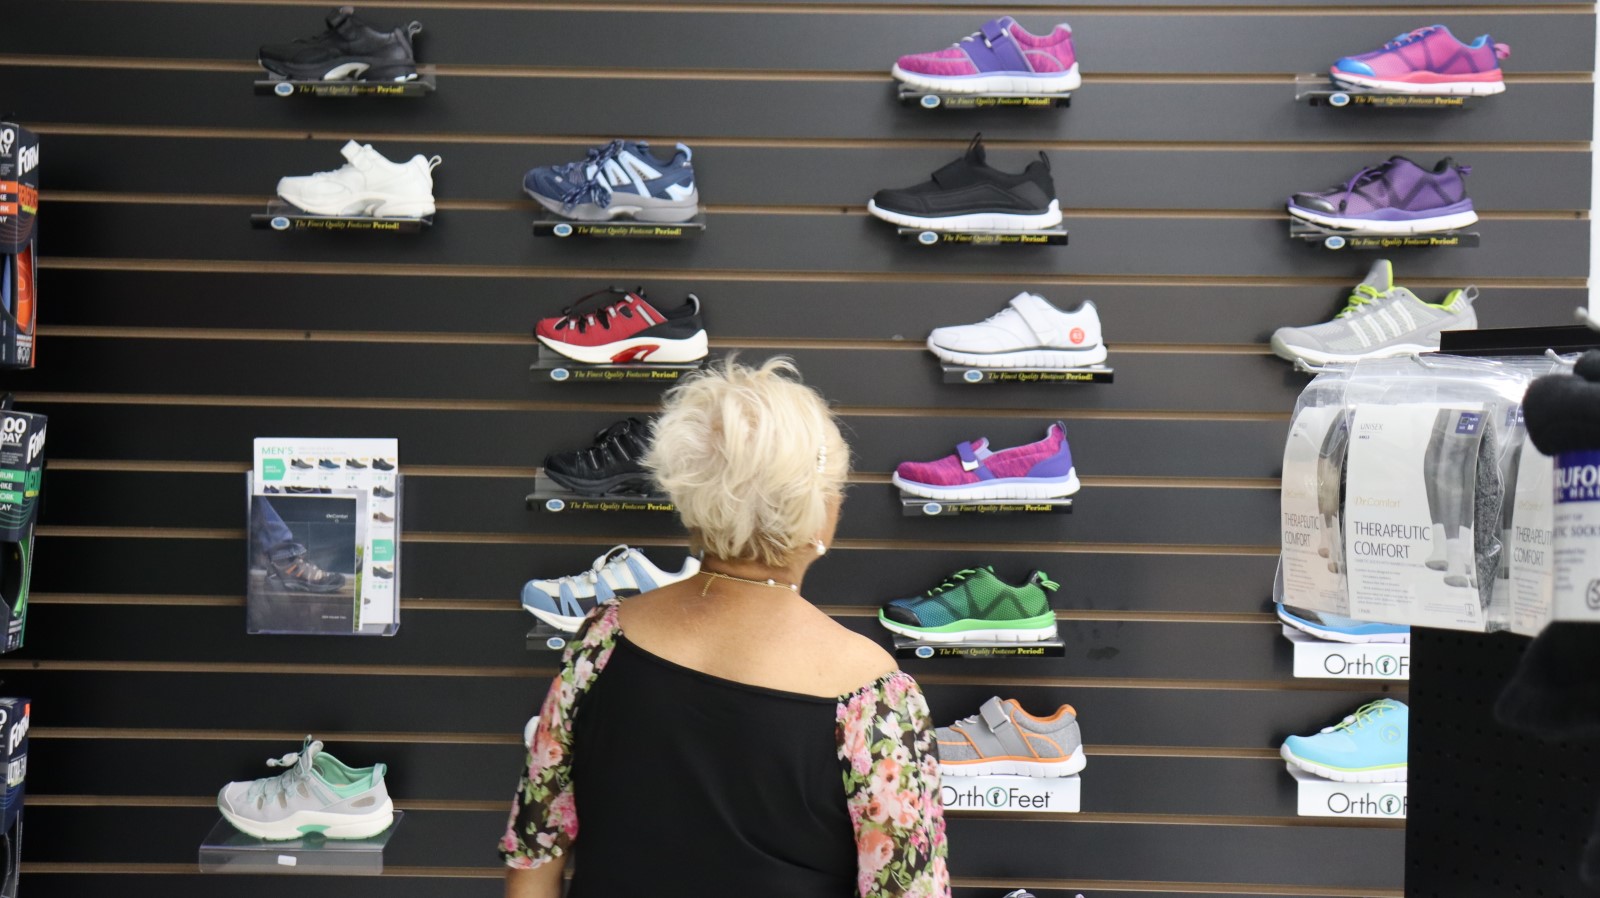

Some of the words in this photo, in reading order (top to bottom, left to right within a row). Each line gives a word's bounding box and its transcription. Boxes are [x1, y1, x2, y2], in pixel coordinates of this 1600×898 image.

[1386, 97, 1407, 105] Quality
[325, 220, 345, 230] Quality
[608, 227, 627, 236] Quality
[973, 235, 993, 243] Quality
[605, 371, 624, 380] Quality
[1019, 373, 1038, 381] Quality
[600, 502, 620, 511] Quality
[648, 503, 674, 511] Period!
[978, 505, 997, 513] Quality
[1284, 513, 1319, 530] THERAPEUTIC
[1353, 521, 1431, 541] THERAPEUTIC
[1285, 531, 1311, 547] COMFORT
[1515, 526, 1553, 546] THERAPEUTI
[1354, 541, 1410, 559] COMFORT
[1514, 547, 1544, 566] COMFORT
[970, 648, 990, 656] Quality
